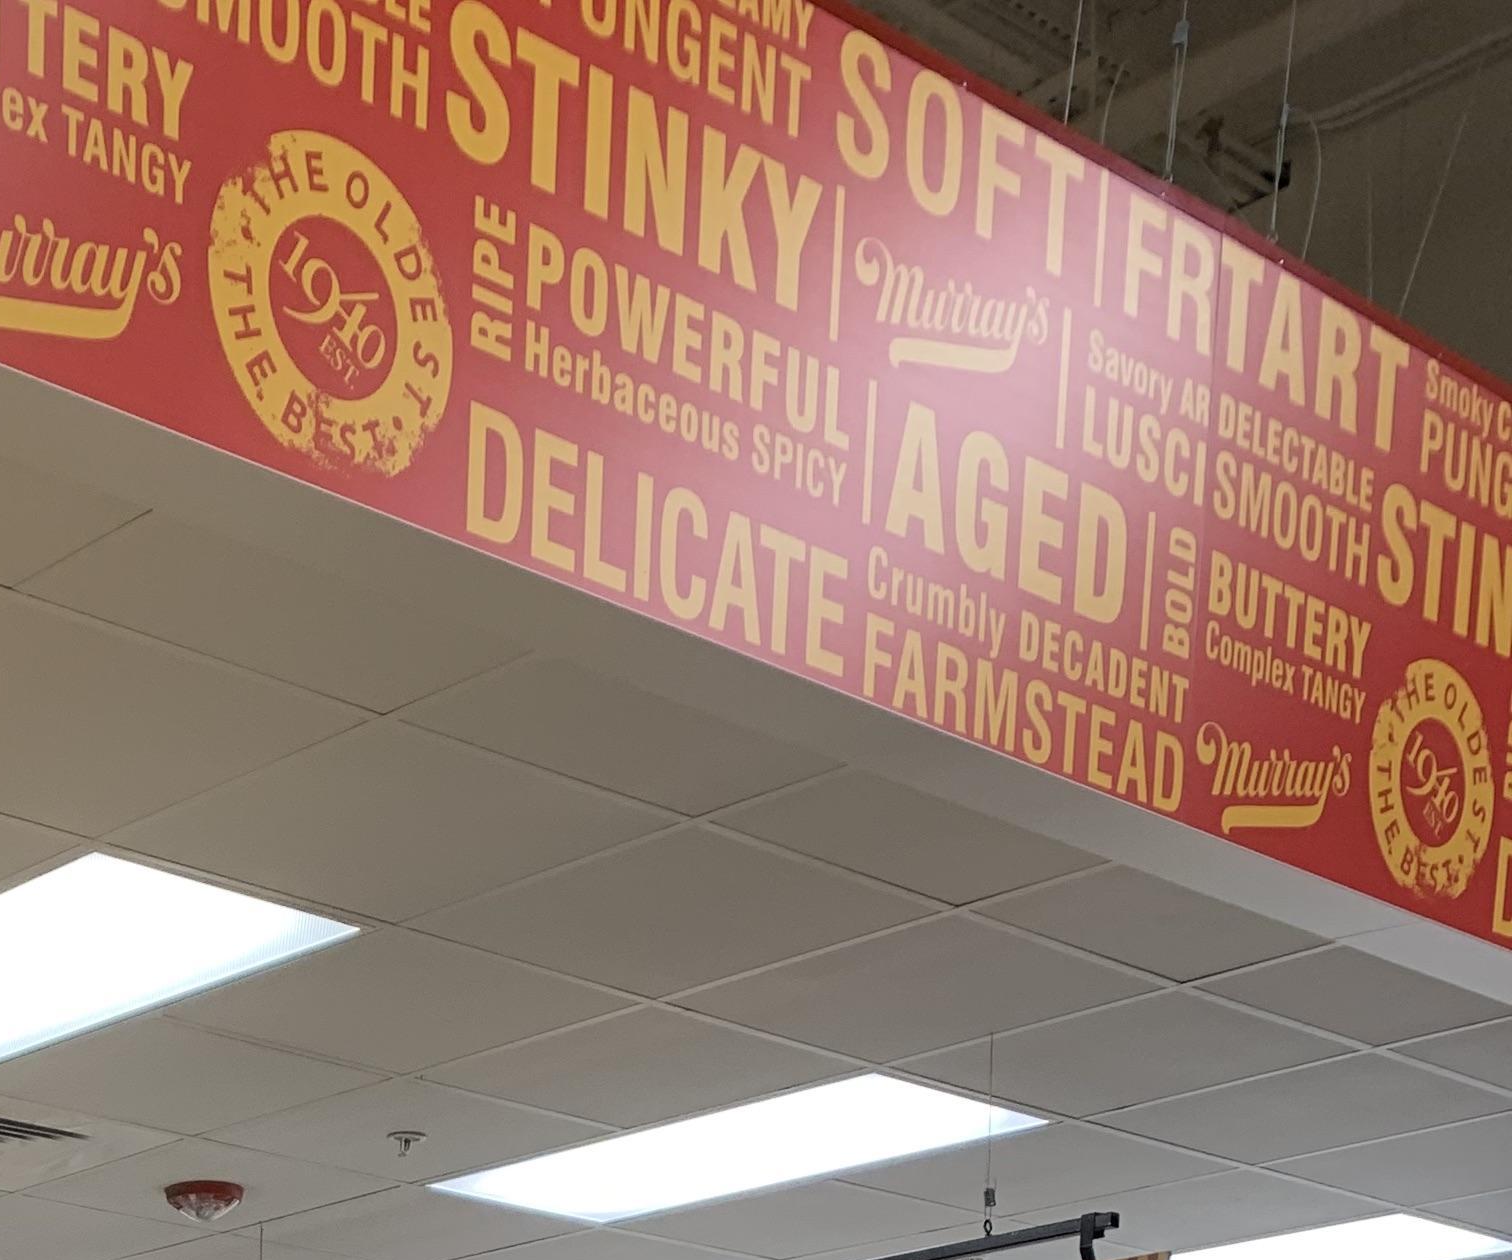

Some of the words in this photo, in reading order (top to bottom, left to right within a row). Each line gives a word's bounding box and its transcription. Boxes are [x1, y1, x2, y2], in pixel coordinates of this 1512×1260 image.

[61, 104, 191, 205] TANGY
[445, 0, 823, 313] STINKY
[836, 29, 1086, 277] SOFT
[223, 264, 278, 392] THE
[279, 231, 385, 370] 1940
[345, 170, 441, 418] OLDEST
[470, 194, 517, 362] RIPE
[527, 222, 849, 450] POWERFUL
[855, 237, 1050, 374] Murray's
[1220, 235, 1410, 452] TART
[525, 320, 740, 461] Herbaceous
[752, 424, 848, 507] SPICY
[1089, 330, 1174, 415] Savory
[1426, 358, 1493, 438] Smoky
[885, 400, 1128, 624] AGED
[1212, 450, 1372, 587] SMOOTH
[1218, 394, 1375, 514] DELECTABLE
[466, 400, 849, 677] DELICATE
[1163, 526, 1197, 660] BOLD
[867, 546, 1006, 658] Crumbly
[1019, 610, 1189, 725] DECADENT
[1205, 620, 1295, 694] Complex
[1302, 664, 1366, 726] TANGY
[1208, 549, 1371, 680] BUTTERY
[862, 612, 1185, 813] FARMSTEAD
[1196, 721, 1352, 835] Murray's
[1406, 731, 1458, 824] 1940
